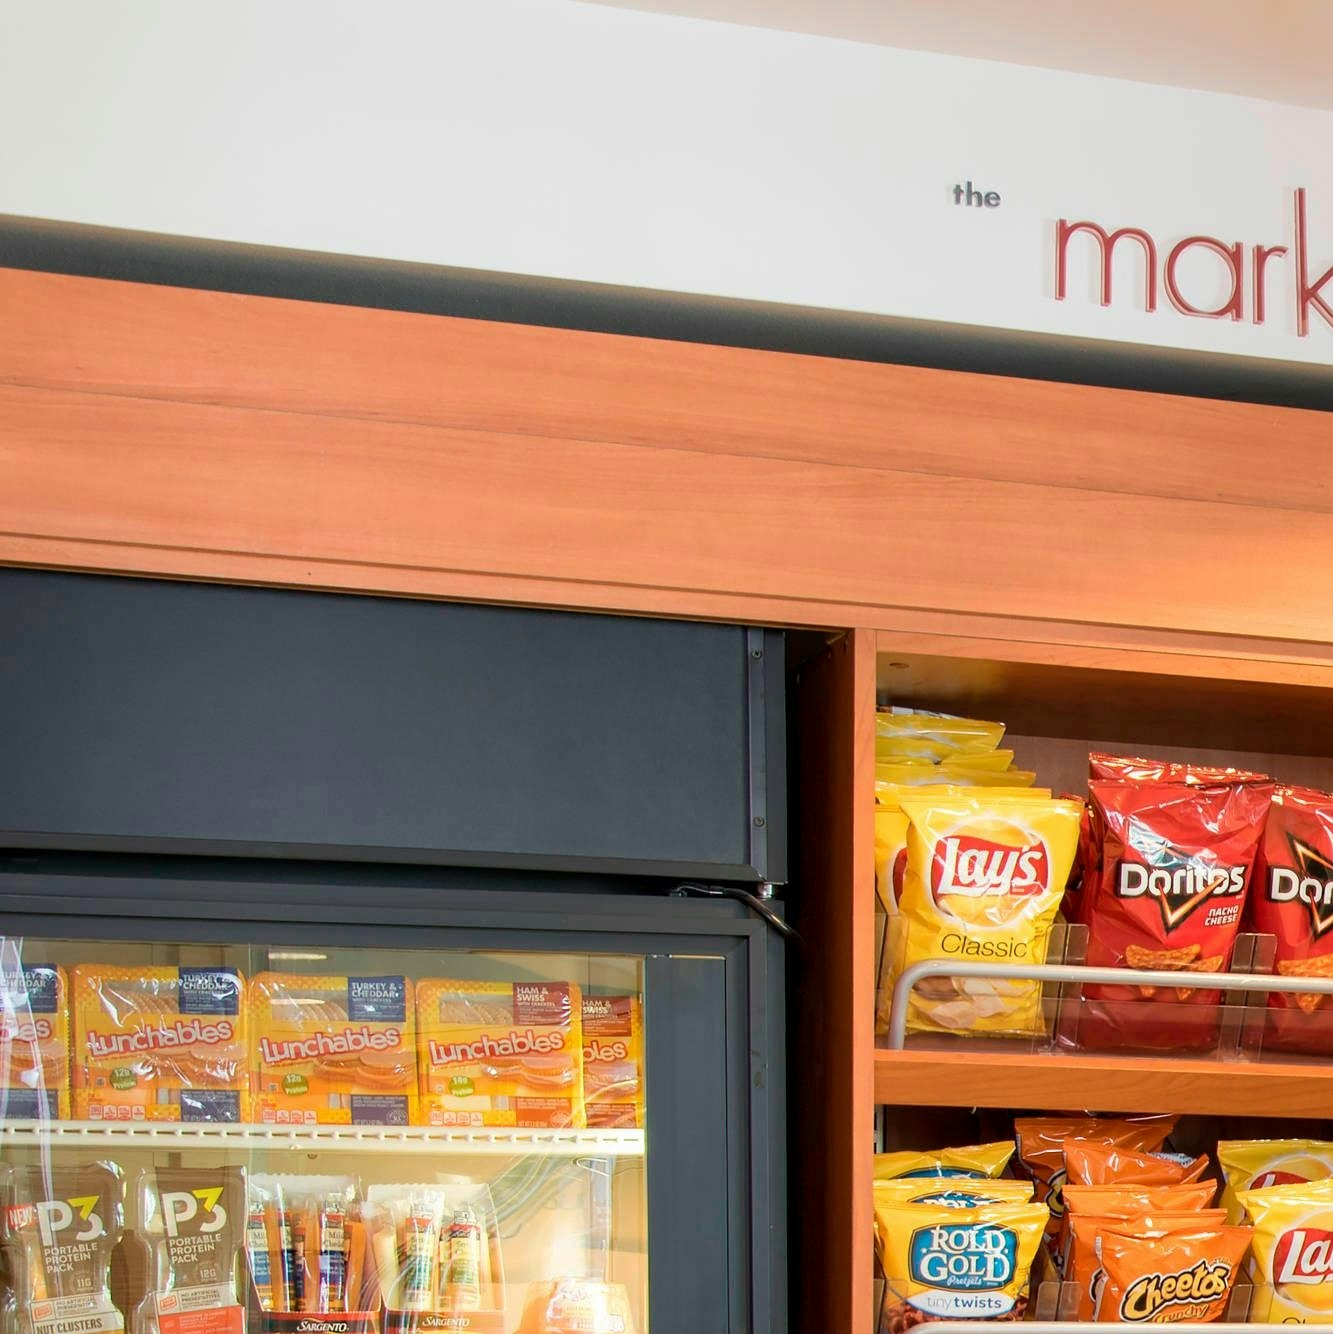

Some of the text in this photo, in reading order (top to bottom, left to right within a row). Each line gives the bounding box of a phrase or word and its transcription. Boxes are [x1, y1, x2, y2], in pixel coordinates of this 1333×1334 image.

[953, 181, 1001, 208] the
[937, 838, 1043, 896] Lay's
[1119, 863, 1245, 896] Doritos
[1208, 906, 1239, 917] NACHO
[1204, 914, 1238, 925] CHEESE
[941, 934, 1027, 958] Classic
[352, 982, 386, 990] TURKEY
[352, 989, 396, 998] CHEDDAR
[517, 993, 545, 1001] SWISS
[88, 1019, 234, 1057] Lunchables
[261, 1026, 401, 1067] Lunchables
[429, 1030, 564, 1066] Lunchables
[162, 1187, 227, 1237] P3
[36, 1195, 104, 1246] P3
[170, 1233, 222, 1247] PORTABLE
[931, 1228, 1006, 1252] ROLD
[45, 1243, 98, 1256] PORTABLE
[170, 1243, 215, 1256] PROTEIN
[45, 1252, 91, 1265] PROTEIN
[171, 1254, 199, 1264] PACK
[47, 1263, 74, 1274] PACK
[920, 1253, 1011, 1282] GOLD
[1121, 1260, 1232, 1322] Cheetos
[927, 1296, 1002, 1310] tiny twists
[57, 1318, 103, 1334] CLUSTERS
[297, 1320, 348, 1332] SARGENTO
[422, 1317, 470, 1327] SARGENTO
